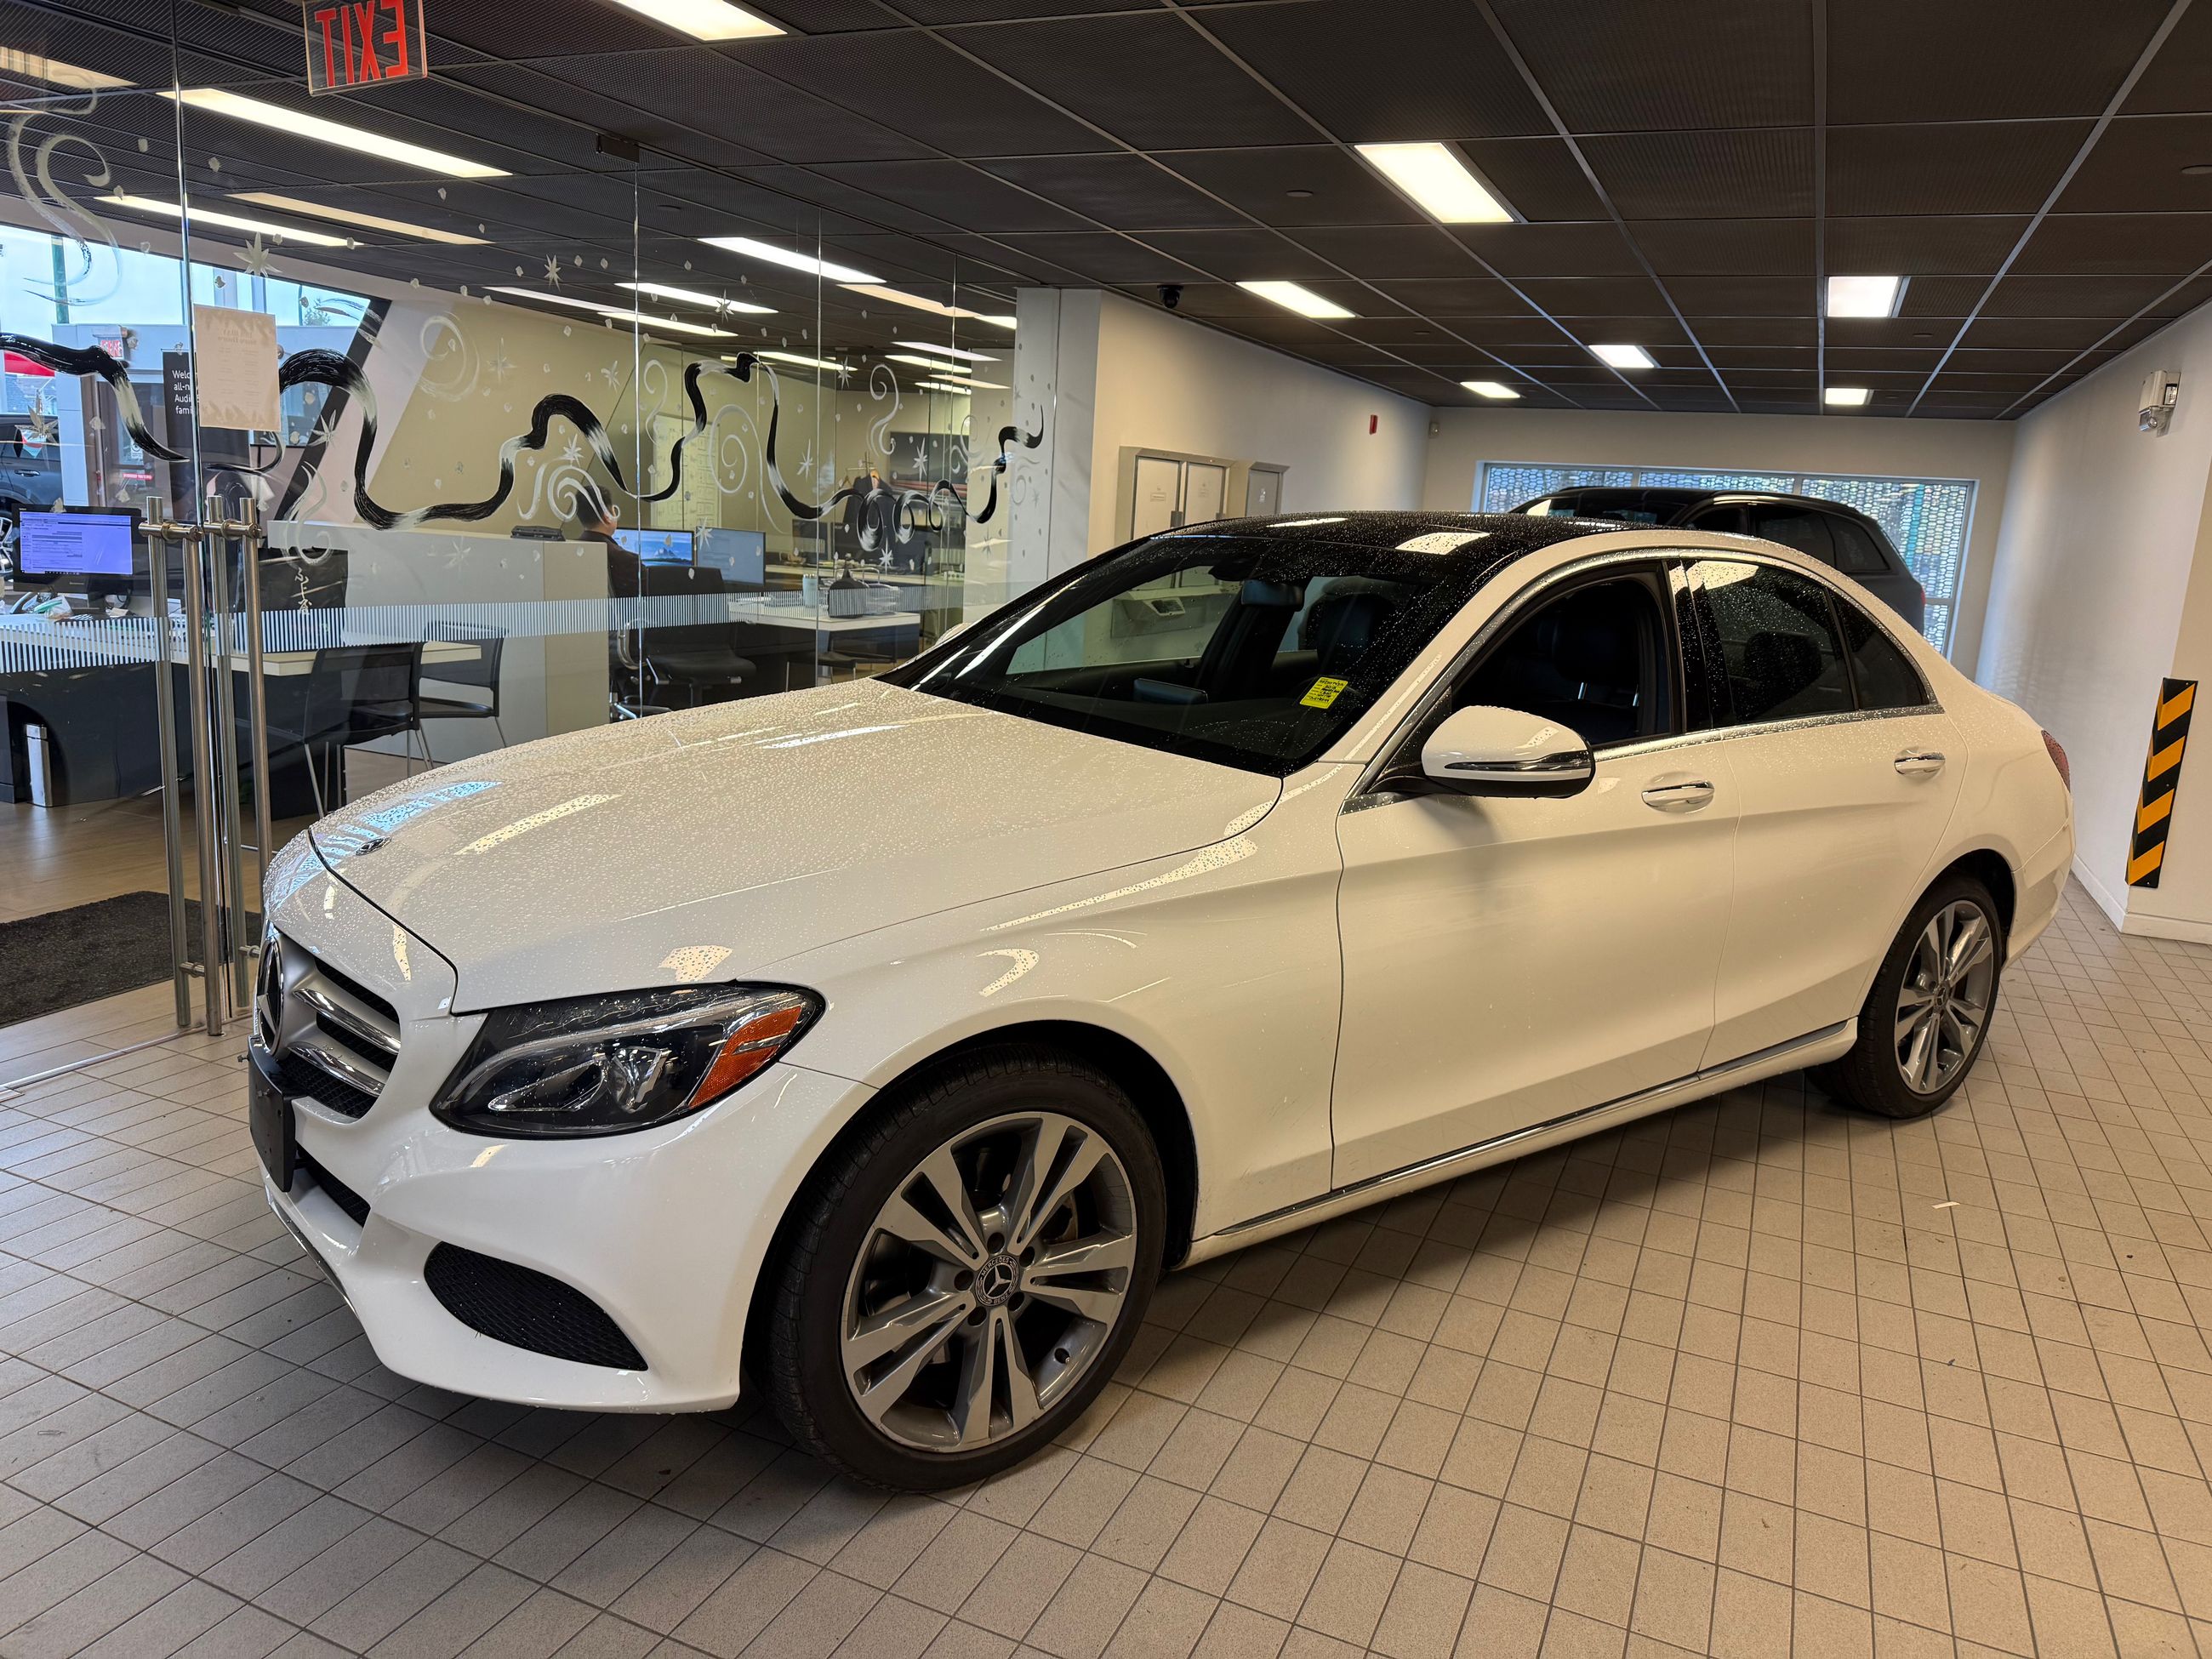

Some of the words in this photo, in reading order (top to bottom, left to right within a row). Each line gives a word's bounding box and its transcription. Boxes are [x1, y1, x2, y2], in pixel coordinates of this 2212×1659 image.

[172, 370, 191, 379] Welc
[174, 382, 191, 391] all-n
[175, 406, 192, 414] fami
[981, 1257, 1010, 1276] MERCEDES
